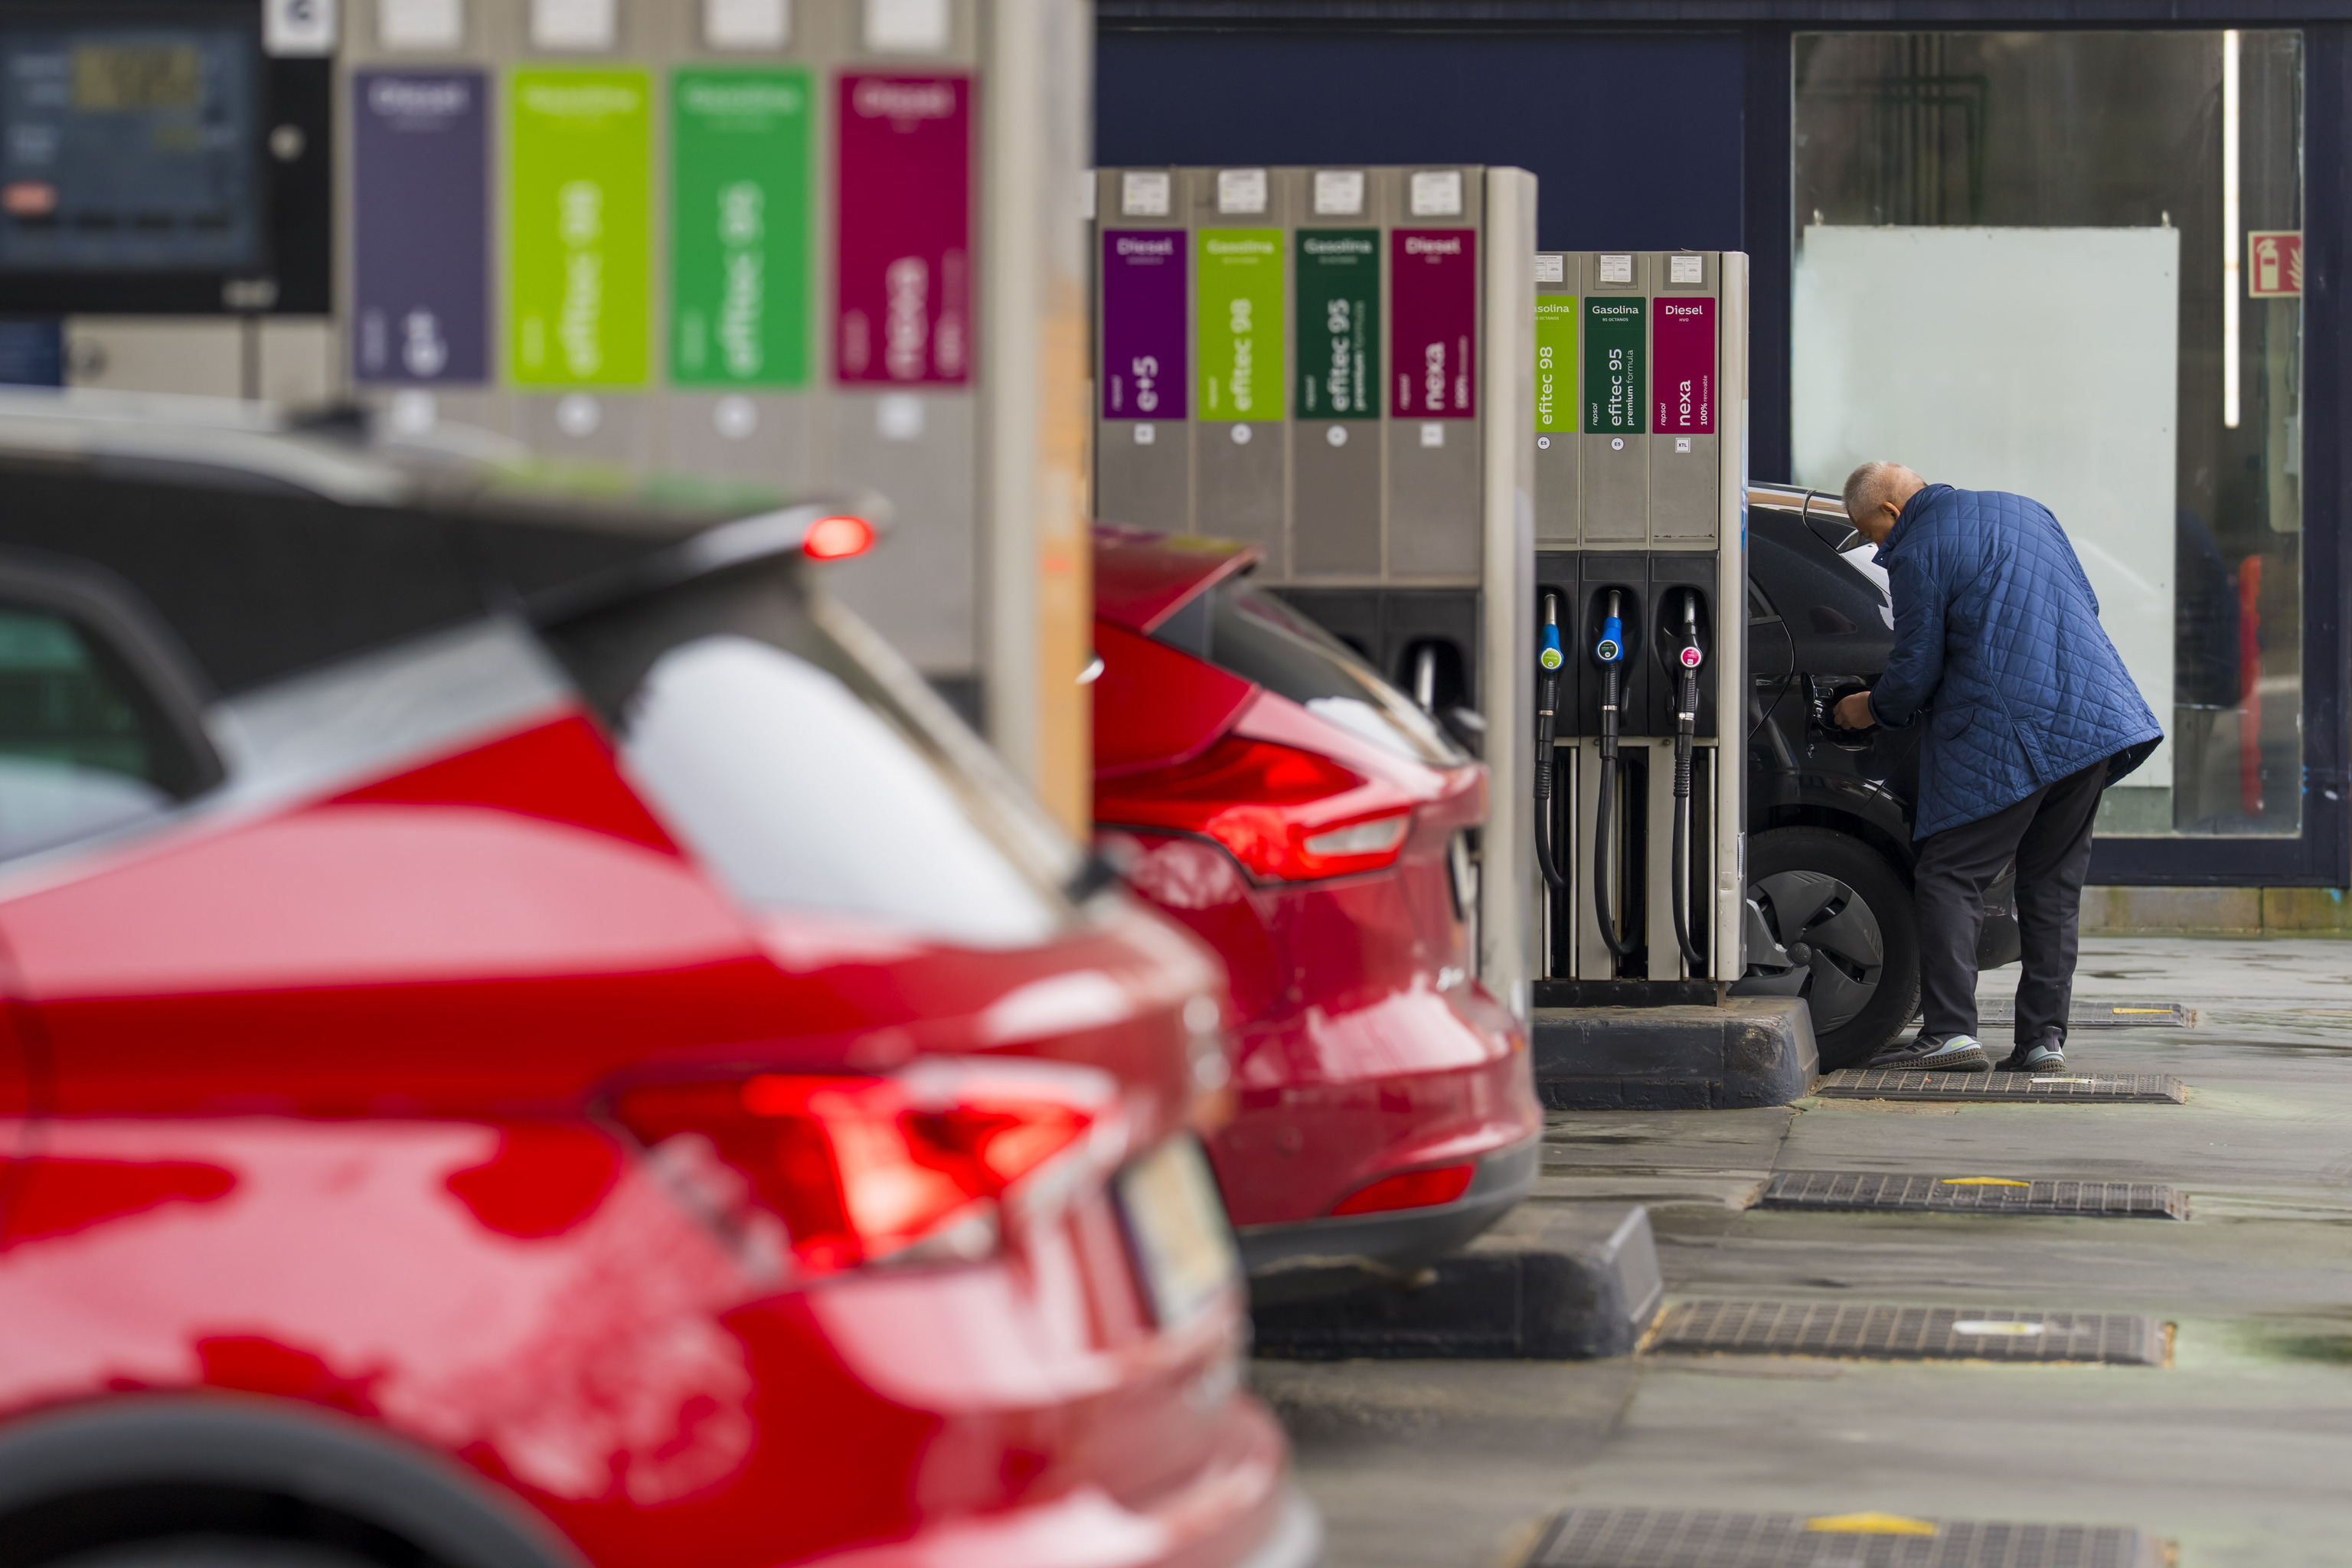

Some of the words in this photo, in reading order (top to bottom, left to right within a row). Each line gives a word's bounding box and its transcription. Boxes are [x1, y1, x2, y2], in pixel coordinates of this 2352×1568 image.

[1117, 237, 1172, 255] Diesel
[1207, 239, 1274, 254] Gasolina
[1304, 237, 1372, 254] Gasolina
[1406, 237, 1461, 254] Diesel
[1230, 299, 1252, 333] 98
[1328, 299, 1350, 333] 95
[1592, 305, 1638, 314] Gasolina
[1665, 305, 1703, 315] Diesel
[1230, 337, 1252, 411] efitec
[1327, 336, 1350, 411] efitec
[1540, 347, 1553, 369] 98
[1609, 348, 1622, 371] 95
[1133, 356, 1158, 412] e+5
[1426, 342, 1446, 410] nexa
[1539, 374, 1553, 425] efitec
[1609, 375, 1622, 426] efitec
[1626, 385, 1635, 426] premium
[1679, 380, 1691, 426] nexa
